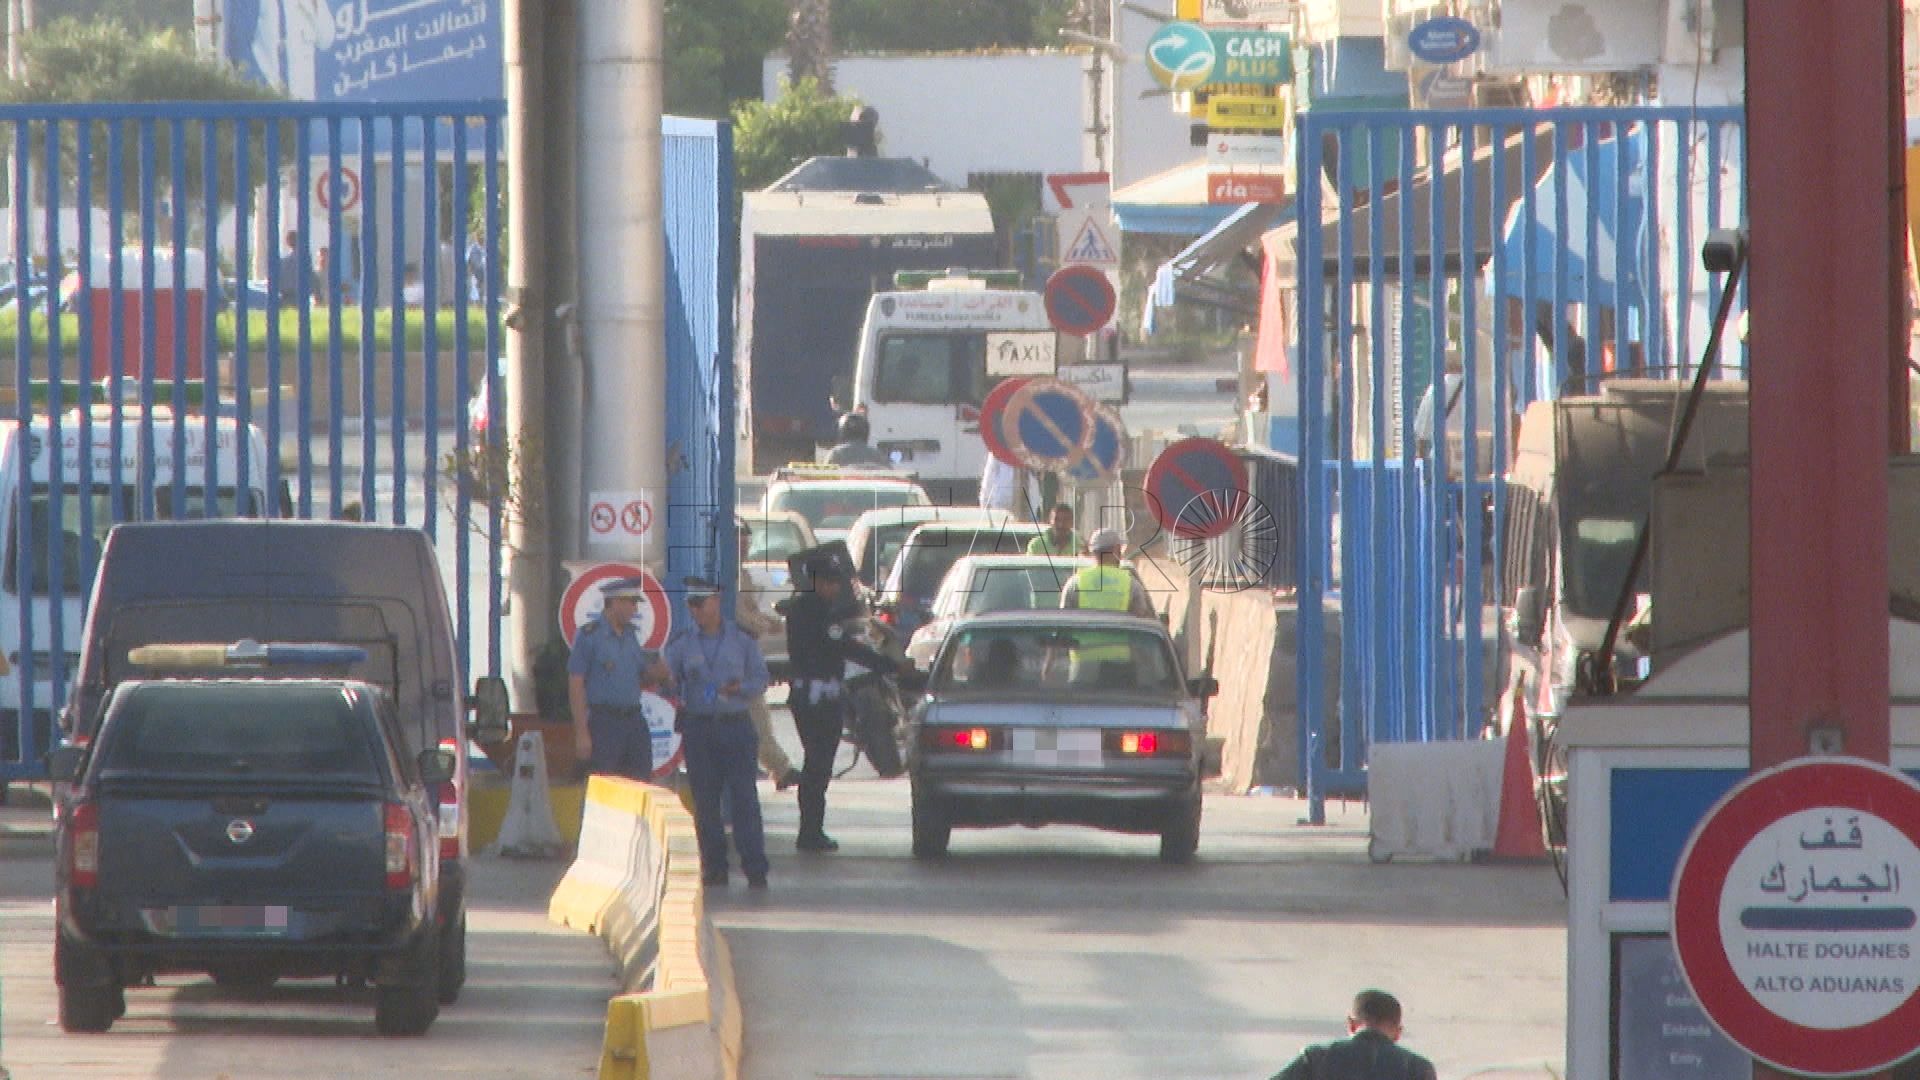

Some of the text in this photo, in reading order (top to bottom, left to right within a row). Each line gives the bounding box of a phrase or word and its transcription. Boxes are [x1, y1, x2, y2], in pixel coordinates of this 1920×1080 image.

[334, 24, 408, 66] المغرب
[1226, 37, 1281, 57] CASH
[1226, 59, 1279, 77] PLUS
[1215, 179, 1248, 198] ria
[1800, 816, 1861, 850] قف
[1760, 861, 1900, 903] الجمارك
[1747, 942, 1911, 959] HALTE DOUANES
[1754, 975, 1905, 993] ALTO ADUANAS
